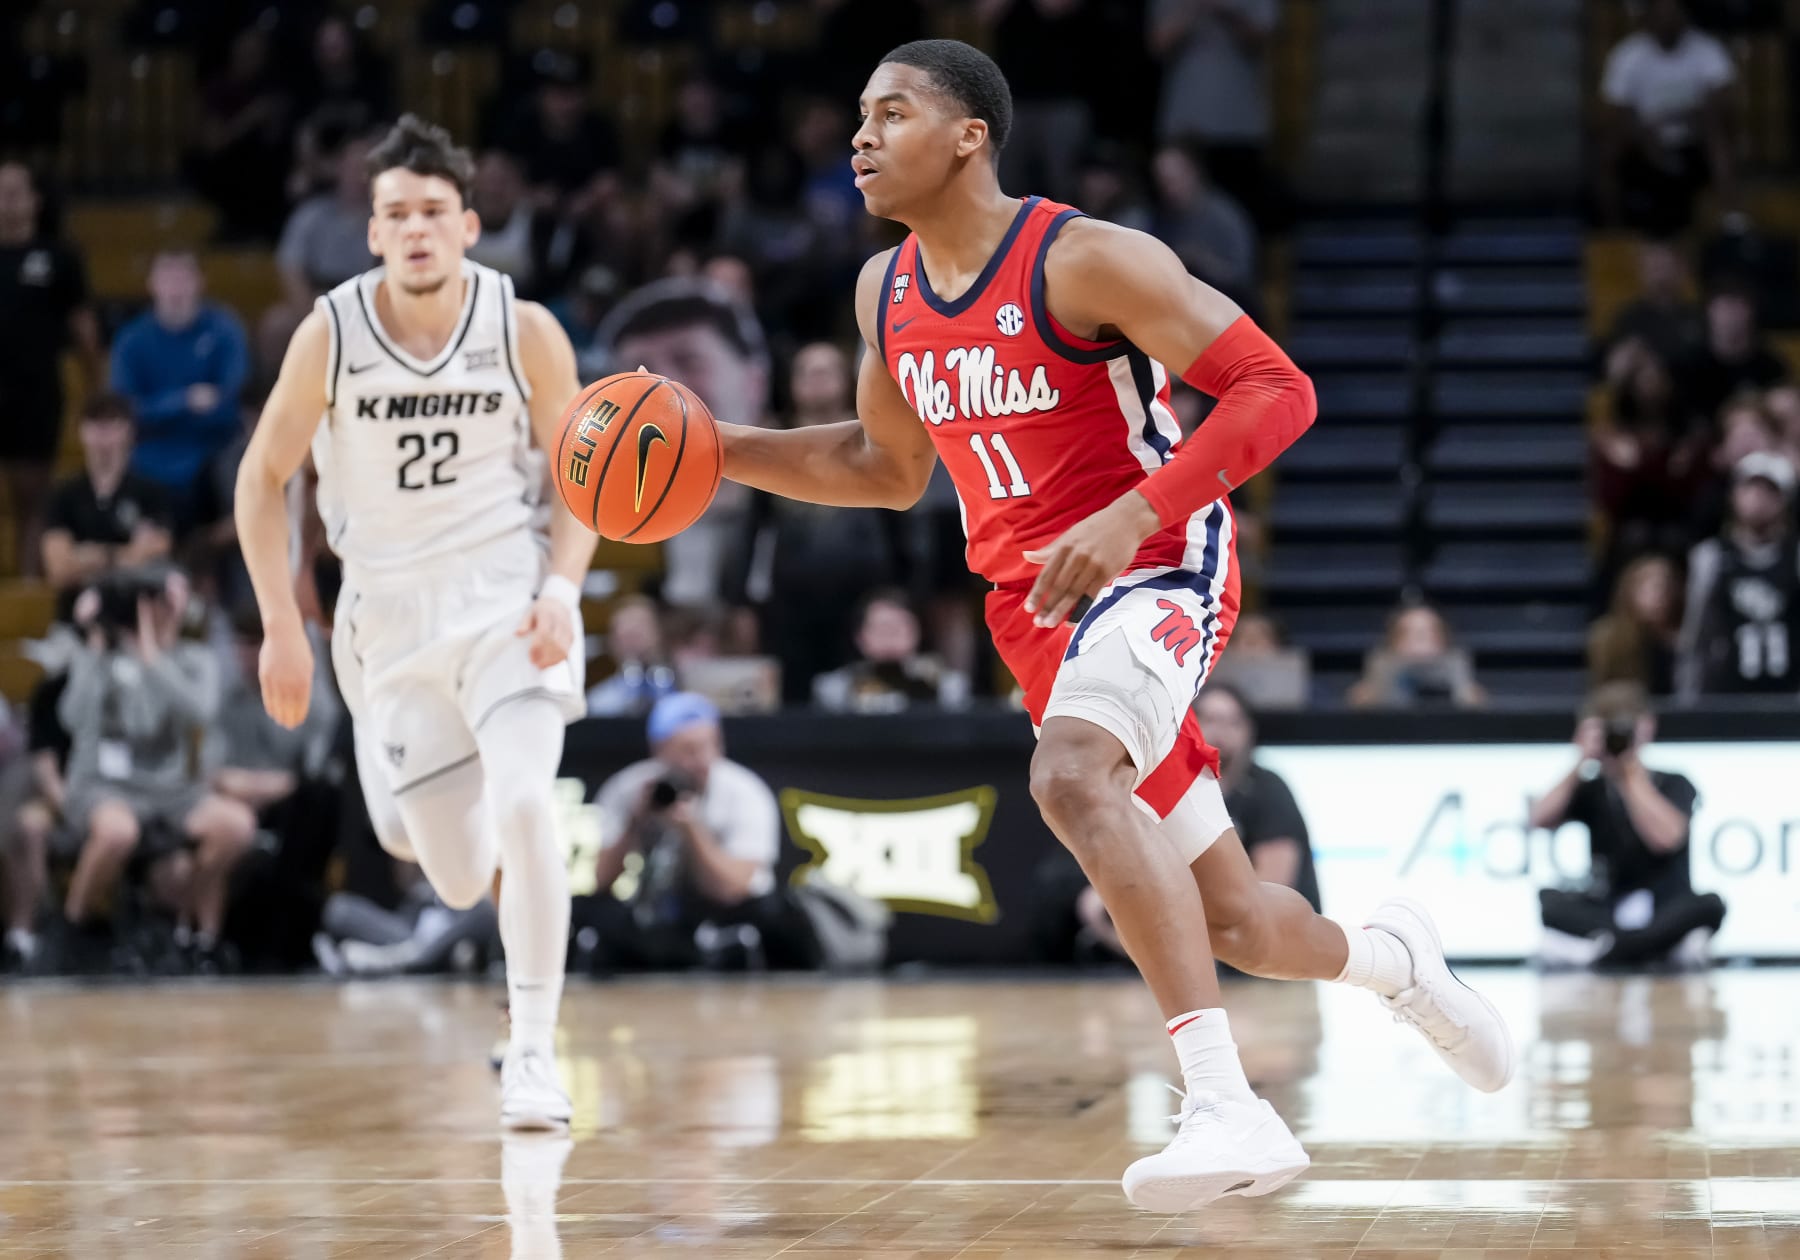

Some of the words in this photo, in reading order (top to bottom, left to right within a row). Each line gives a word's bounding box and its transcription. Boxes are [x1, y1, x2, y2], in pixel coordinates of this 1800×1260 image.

[893, 288, 905, 304] 24
[995, 303, 1024, 336] SEC
[356, 392, 502, 420] KNIGHTS
[898, 350, 955, 426] Ole
[945, 345, 1060, 420] Miss
[397, 431, 460, 490] 22
[568, 398, 622, 489] ELITE
[969, 433, 1032, 499] 11
[1734, 622, 1790, 679] 11
